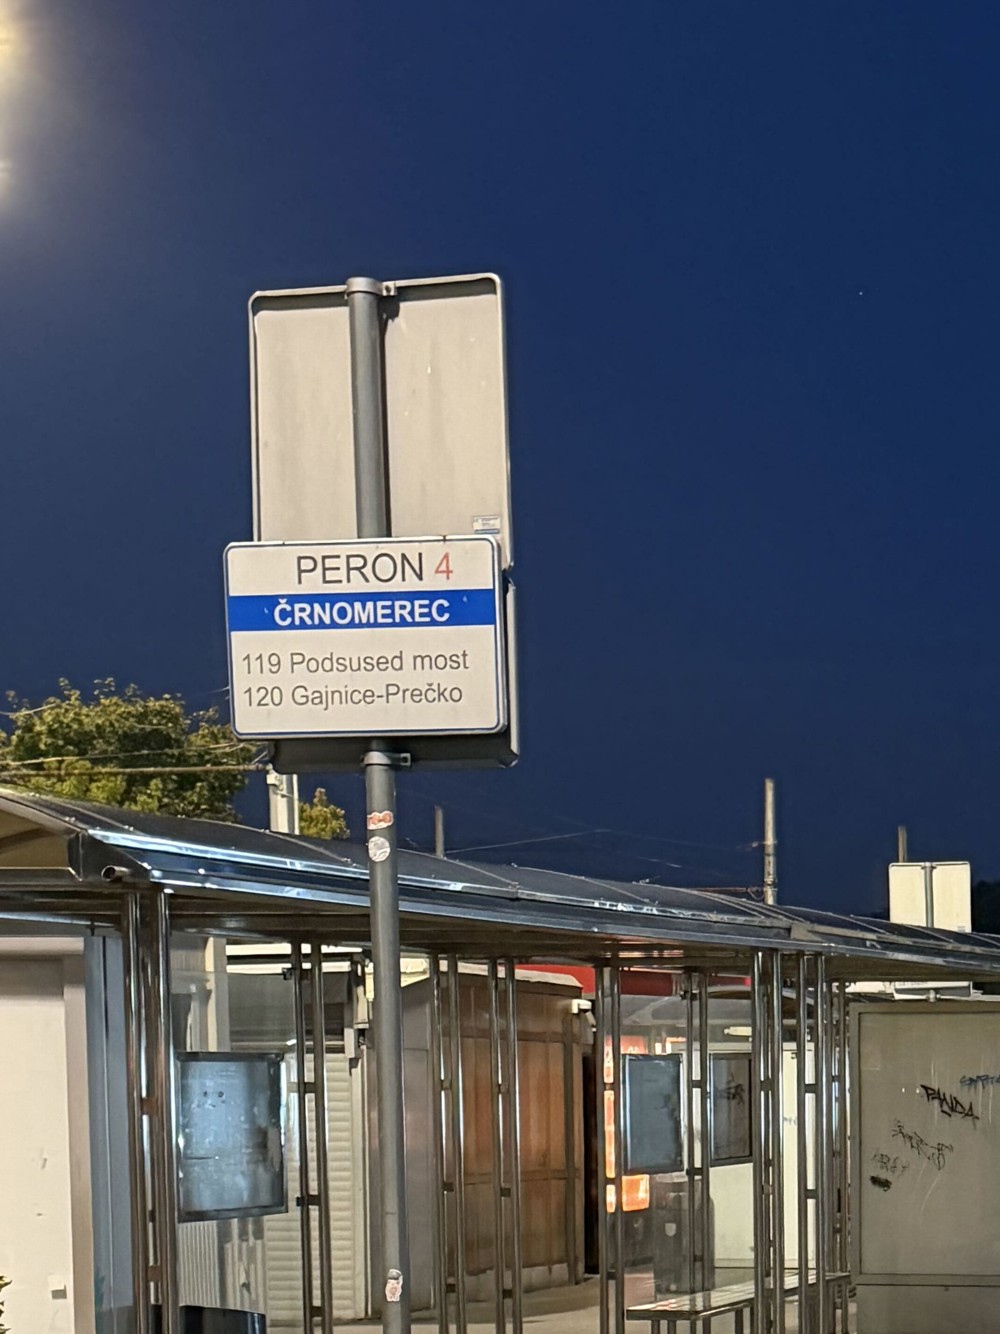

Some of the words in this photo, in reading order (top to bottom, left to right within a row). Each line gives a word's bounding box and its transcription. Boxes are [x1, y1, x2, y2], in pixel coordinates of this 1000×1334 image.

[297, 552, 424, 585] PERON
[434, 552, 454, 581] 4
[273, 598, 451, 626] ČRNOMEREC
[242, 653, 282, 675] 119
[290, 651, 404, 674] Podsused
[412, 650, 470, 671] most
[243, 686, 284, 707] 120
[291, 682, 463, 711] Gajnice-Prečko
[920, 1084, 980, 1120] PANDA
